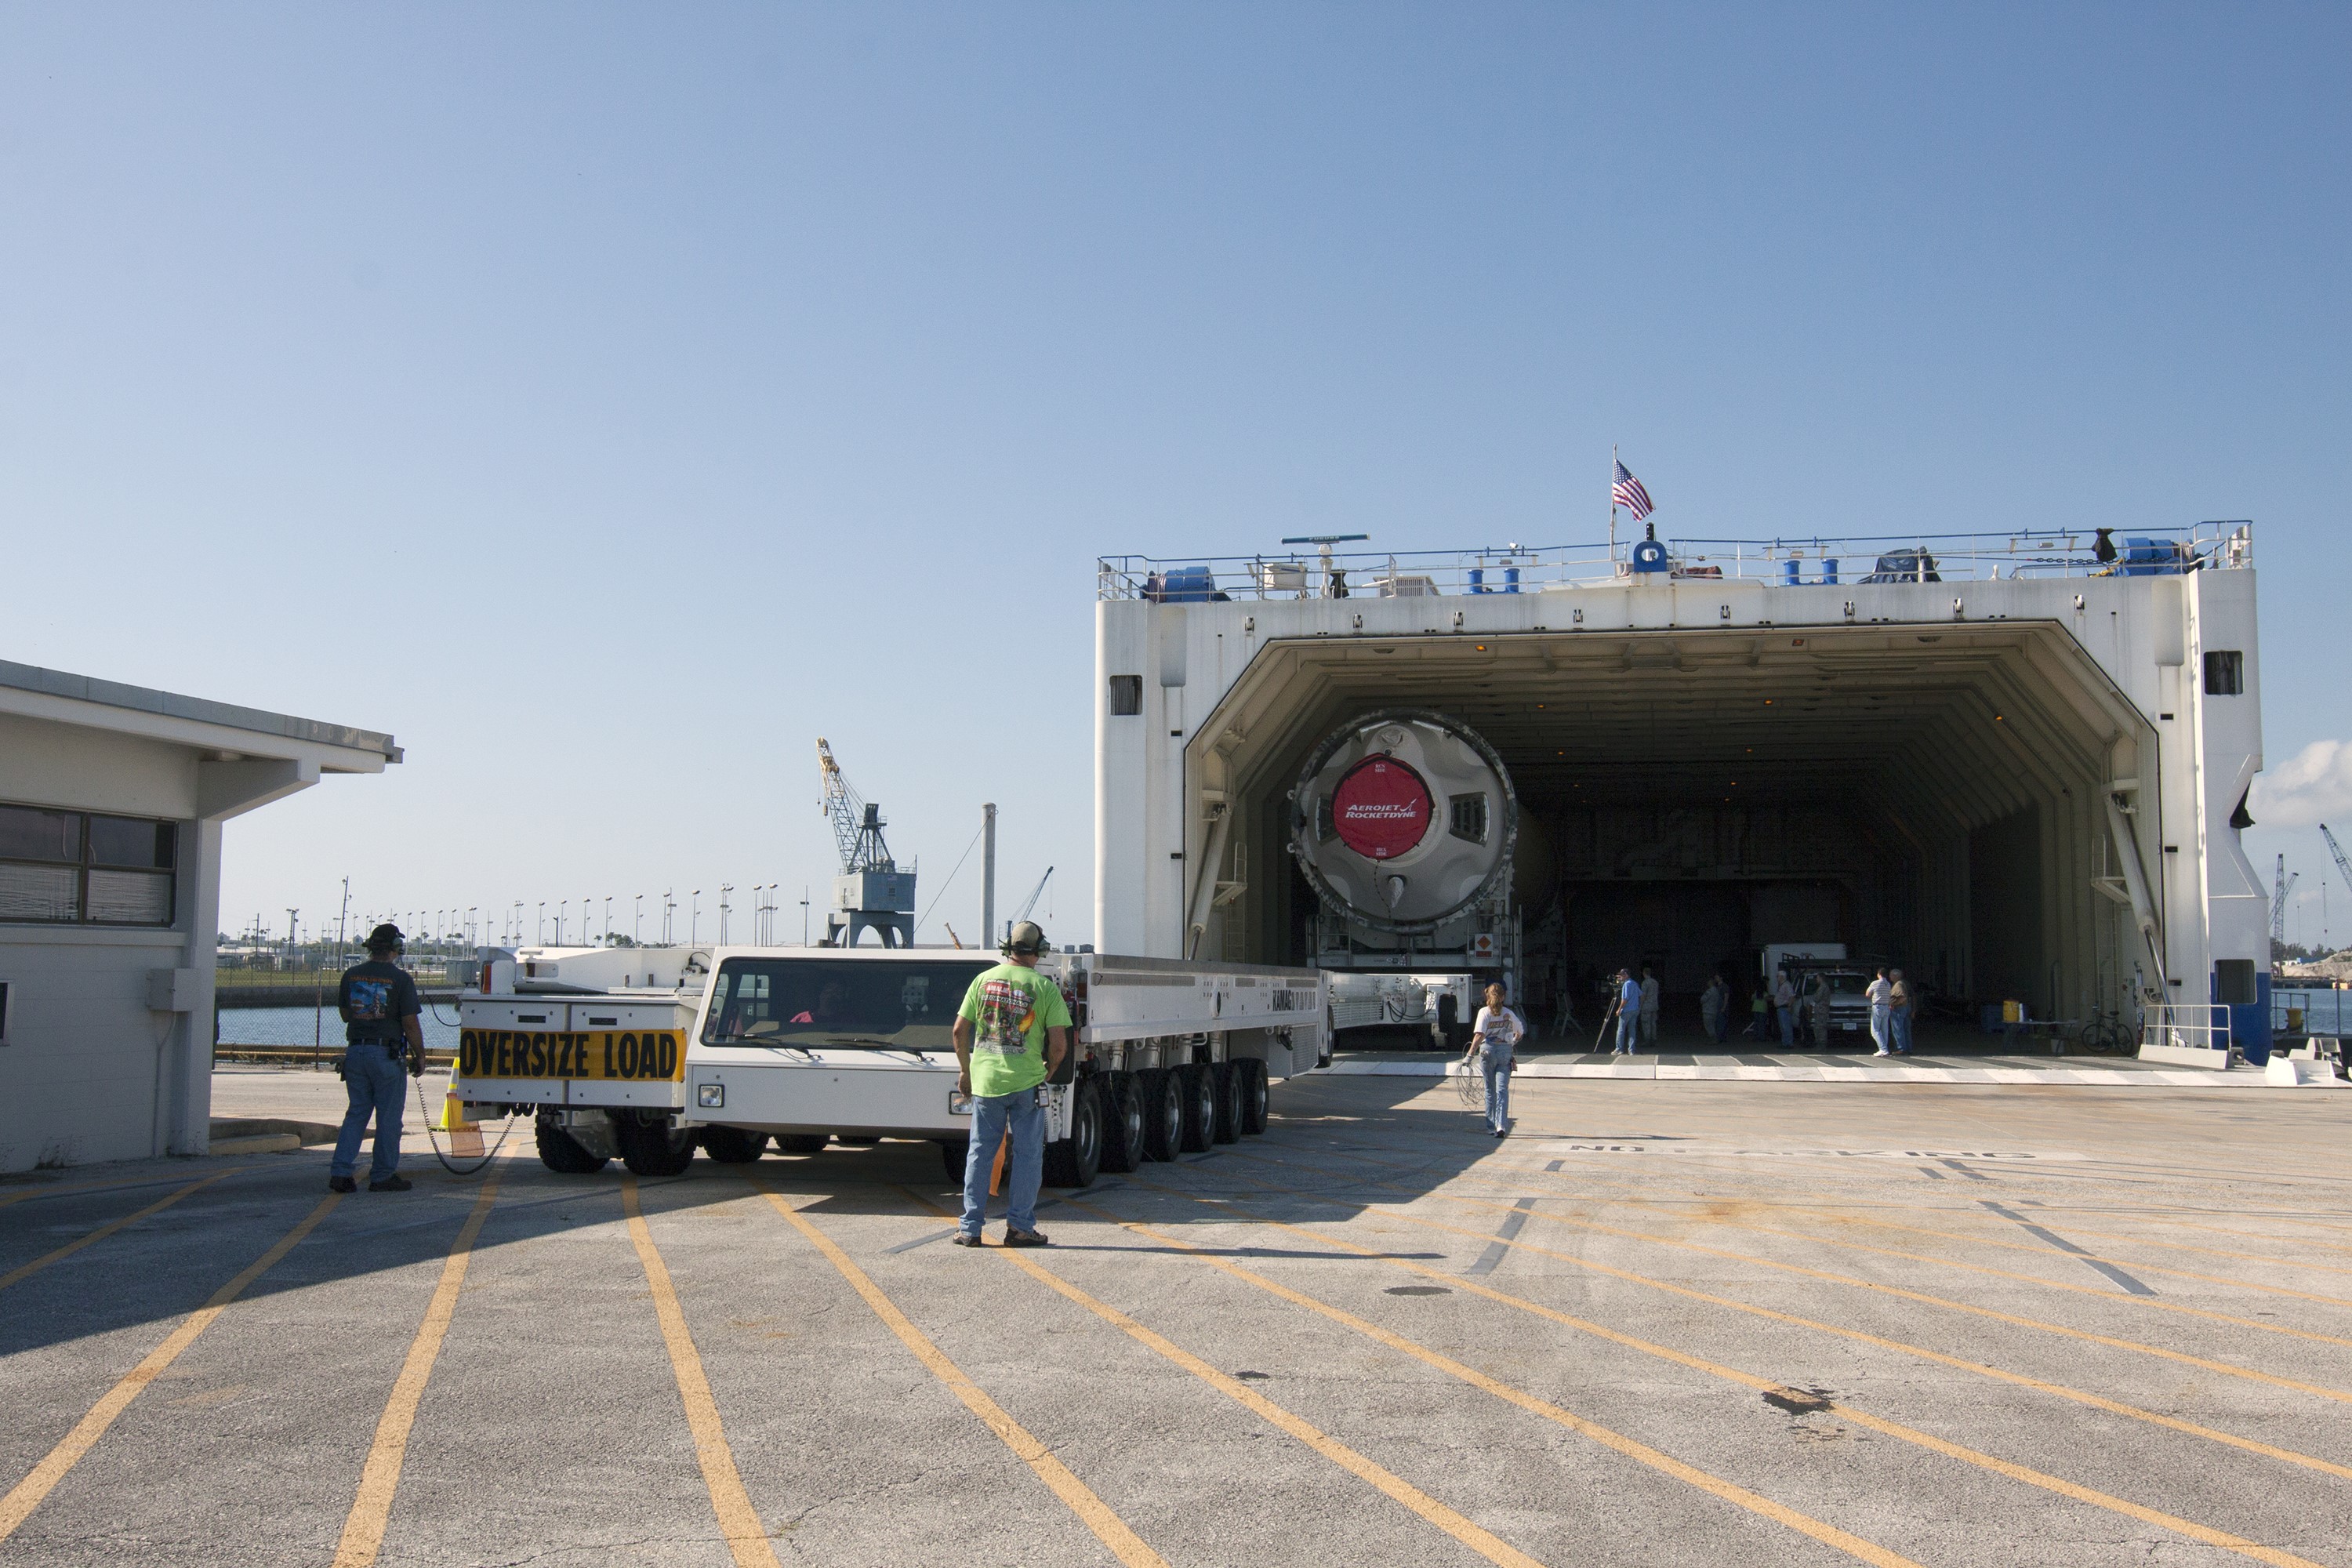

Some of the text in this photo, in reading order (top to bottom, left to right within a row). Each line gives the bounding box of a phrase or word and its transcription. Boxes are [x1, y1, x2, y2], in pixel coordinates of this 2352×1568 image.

[1272, 989, 1292, 1011] KAMAG
[459, 1030, 677, 1080] OVERSIZE LOAD
[1673, 1147, 2037, 1159] ARKING
